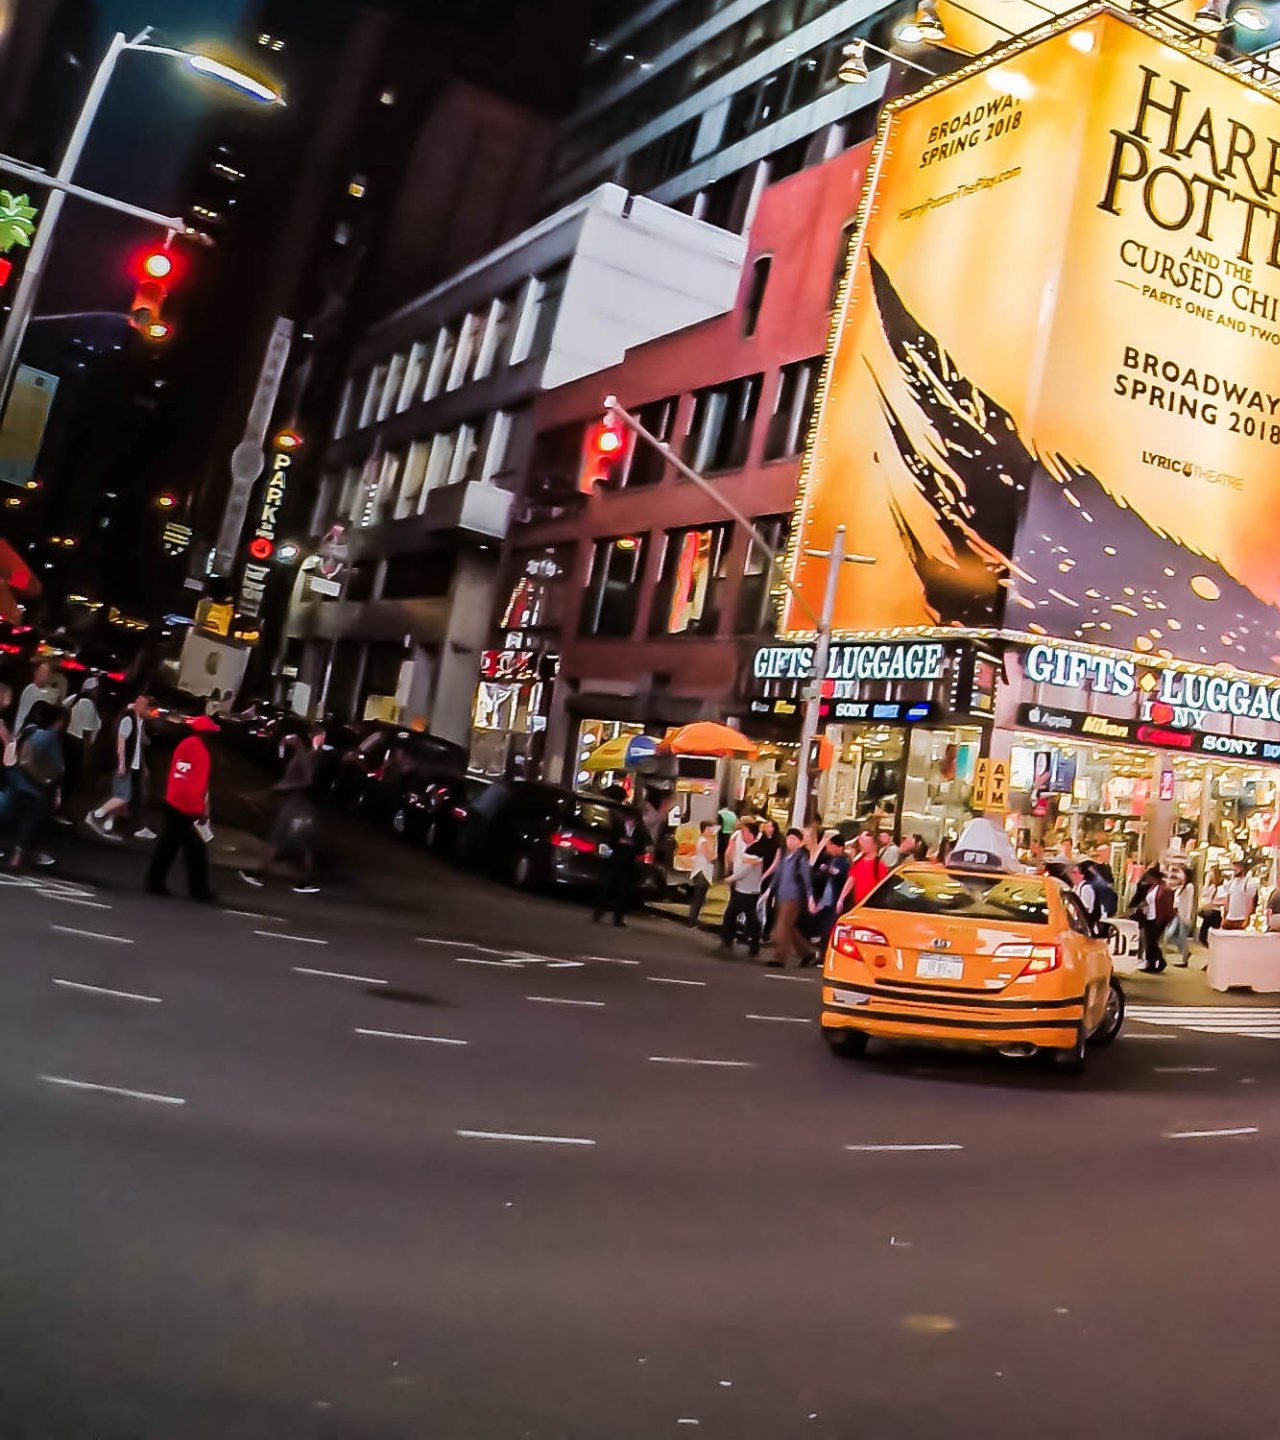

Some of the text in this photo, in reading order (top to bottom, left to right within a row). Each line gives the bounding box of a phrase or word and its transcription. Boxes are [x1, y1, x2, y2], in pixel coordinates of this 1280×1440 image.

[917, 111, 1023, 170] SPRING 2018
[1119, 239, 1224, 301] CURSED
[1182, 245, 1254, 285] AND THE
[1140, 283, 1183, 313] PARTS
[1184, 296, 1215, 324] ONE
[1215, 308, 1247, 335] AND
[1113, 373, 1218, 426] SPRING
[1141, 452, 1183, 477] LYRIC
[752, 643, 944, 679] GIFTS LUGGAGE
[1025, 643, 1136, 697] GIFTS
[1170, 706, 1207, 731] NY
[1201, 734, 1259, 756] SONY
[991, 763, 1005, 804] ATM
